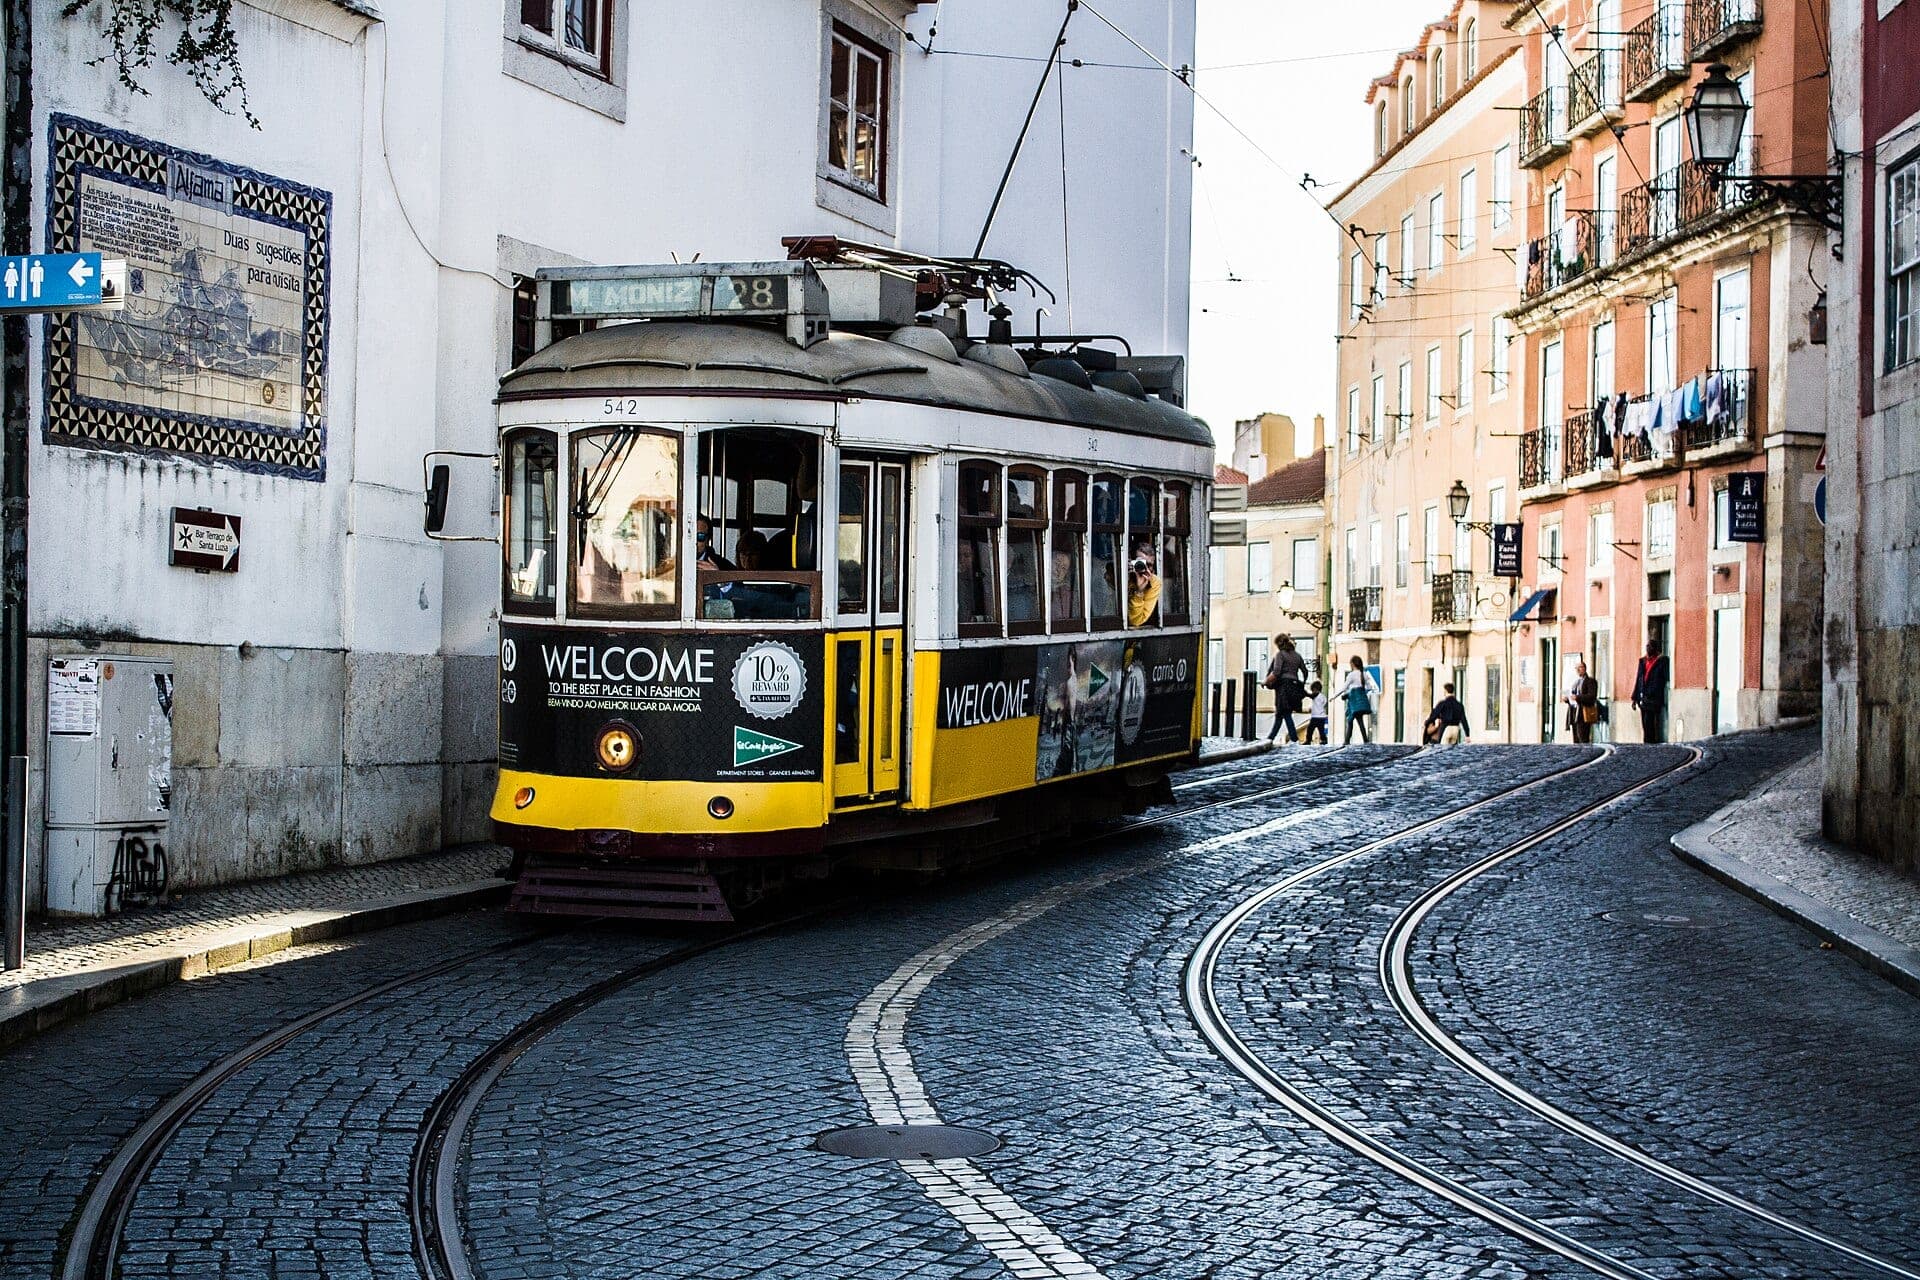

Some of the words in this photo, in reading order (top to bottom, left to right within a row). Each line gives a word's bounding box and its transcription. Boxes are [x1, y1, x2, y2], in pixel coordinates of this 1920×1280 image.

[175, 164, 224, 203] Alfama
[224, 230, 250, 251] Duas
[256, 242, 302, 266] sugestões
[248, 268, 271, 284] para
[272, 272, 300, 292] visita
[604, 281, 692, 306] MONIZ
[728, 278, 773, 309] 28
[604, 399, 637, 414] 542
[196, 530, 204, 538] Bar
[206, 530, 225, 543] Terraço
[226, 534, 232, 542] de
[199, 540, 214, 550] Santa
[542, 644, 714, 682] WELCOME
[1152, 658, 1174, 682] carris
[549, 682, 560, 693] TO
[562, 682, 578, 694] THE
[580, 684, 600, 695] BEST
[602, 684, 632, 696] PLACE
[635, 686, 648, 696] IN
[650, 686, 700, 698] FASHION
[752, 682, 790, 692] REWARD
[548, 698, 584, 708] BEM-VINDO
[584, 700, 597, 708] AO
[598, 700, 629, 710] MELHOR
[630, 702, 658, 711] LUGAR
[658, 702, 672, 712] DA
[672, 703, 702, 712] MODA
[946, 678, 1030, 728] WELCOME
